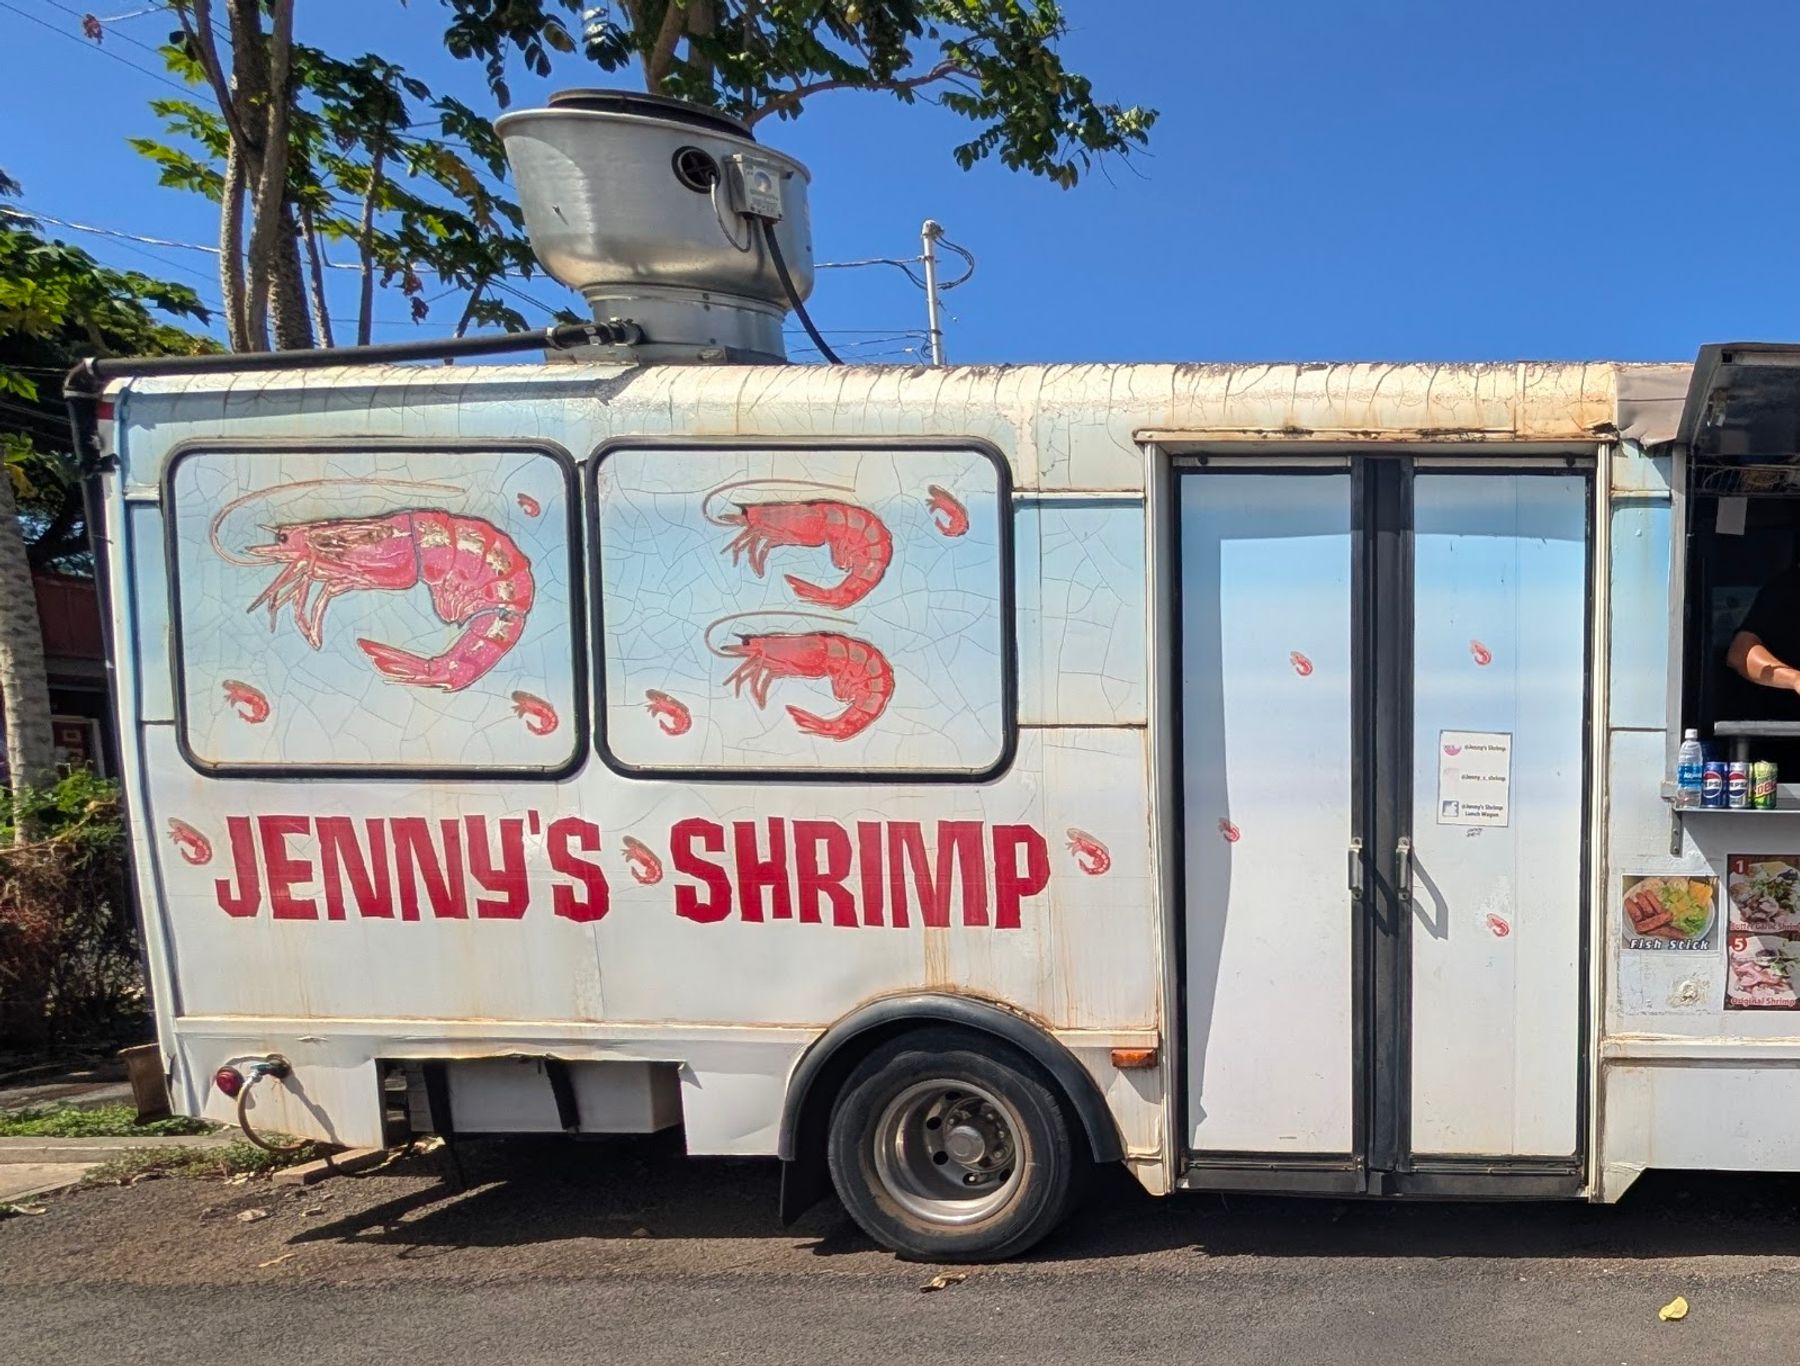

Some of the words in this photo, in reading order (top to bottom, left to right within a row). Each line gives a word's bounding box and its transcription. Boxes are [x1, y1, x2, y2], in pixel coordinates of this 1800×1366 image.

[215, 810, 609, 922] JENNY'S
[670, 816, 1050, 929] SHRIMP
[1736, 859, 1744, 873] 1
[1630, 938, 1662, 950] Fish
[1668, 938, 1709, 950] Stick
[1734, 938, 1744, 950] 5
[1731, 997, 1765, 1007] Original
[1766, 997, 1796, 1007] Shrimp
